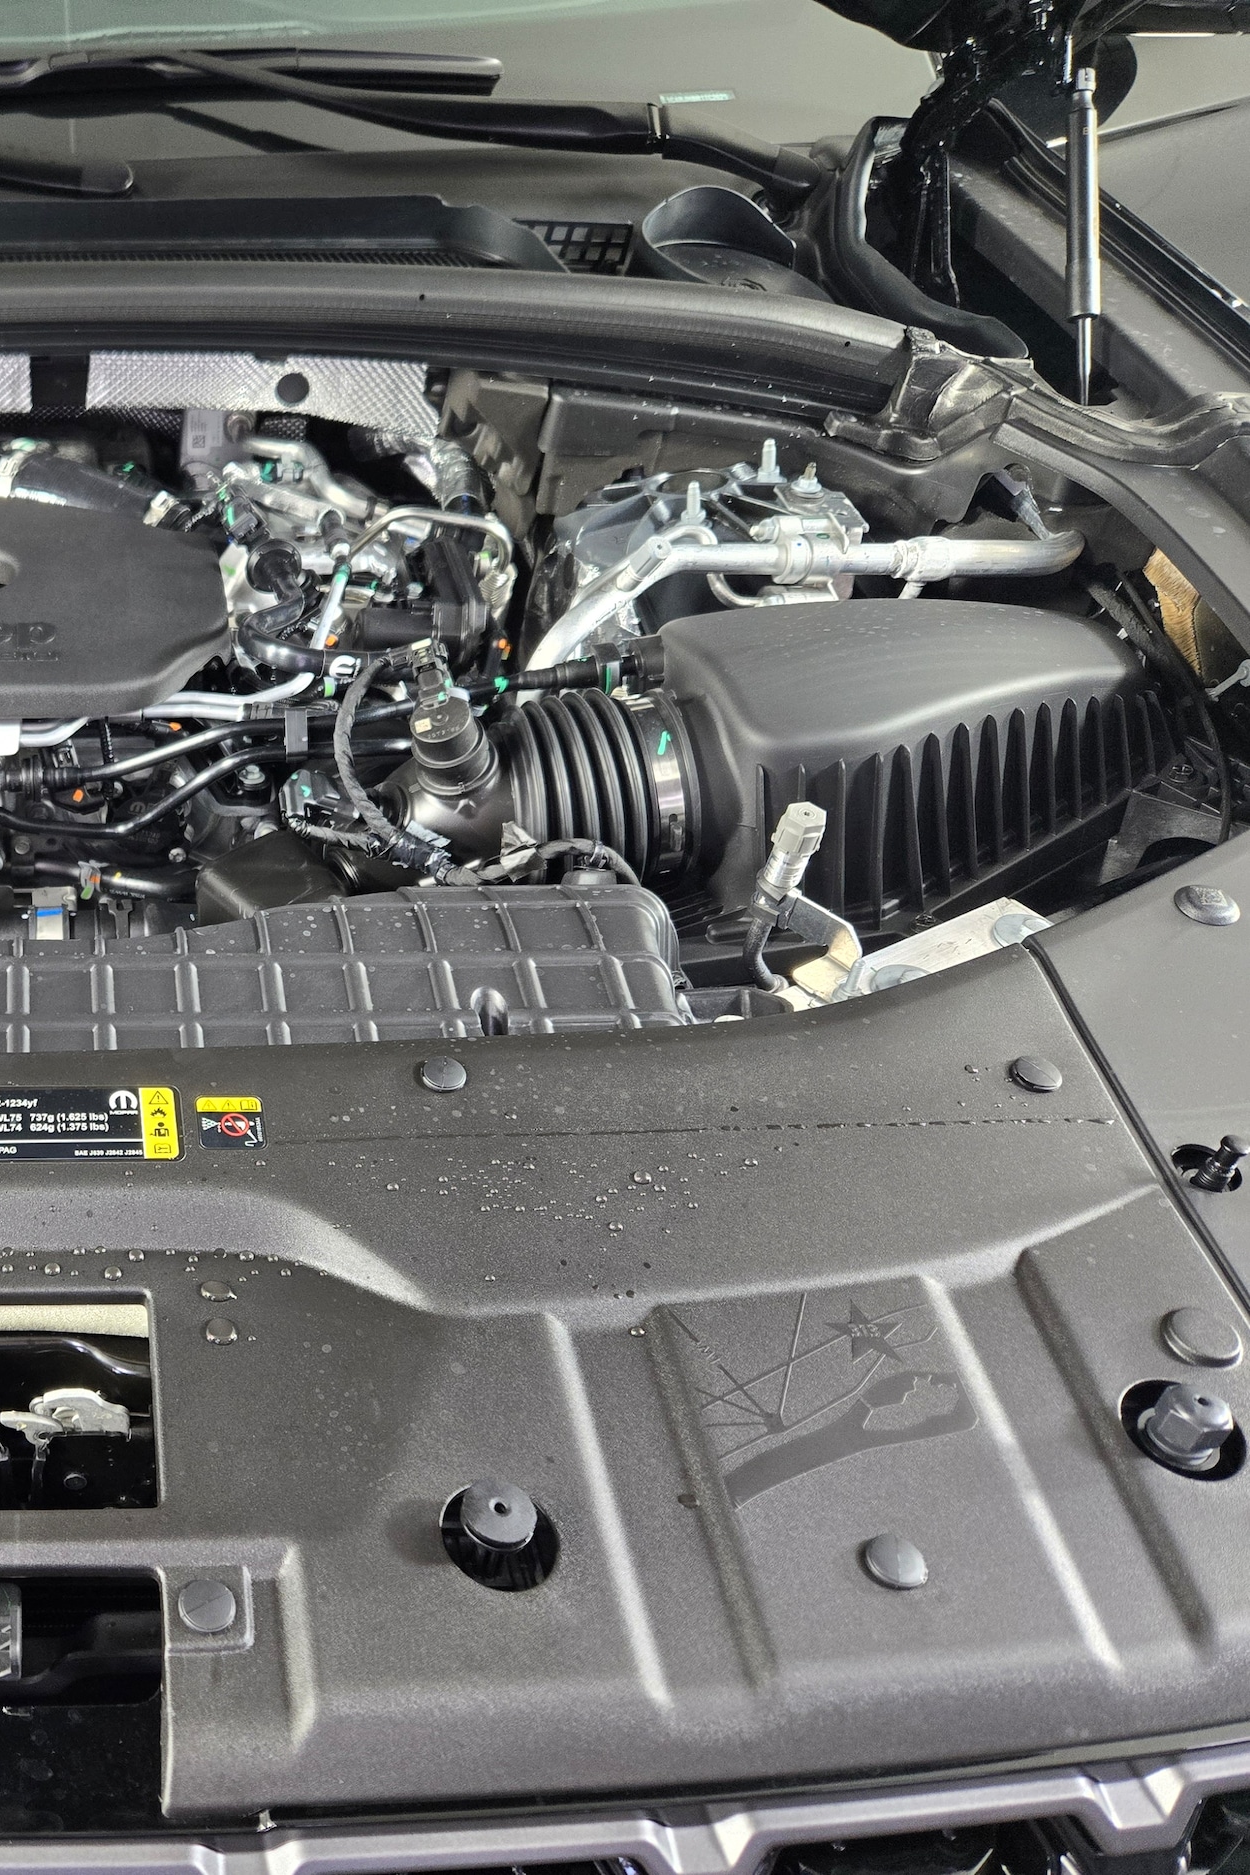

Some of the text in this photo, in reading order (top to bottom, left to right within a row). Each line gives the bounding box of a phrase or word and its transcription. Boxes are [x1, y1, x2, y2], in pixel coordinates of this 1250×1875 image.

[29, 1112, 55, 1123] 737g
[56, 1112, 87, 1123] (1.625
[89, 1112, 109, 1122] lbs)
[29, 1122, 55, 1133] 624g
[57, 1122, 88, 1132] (1.375
[89, 1122, 110, 1132] lbs)
